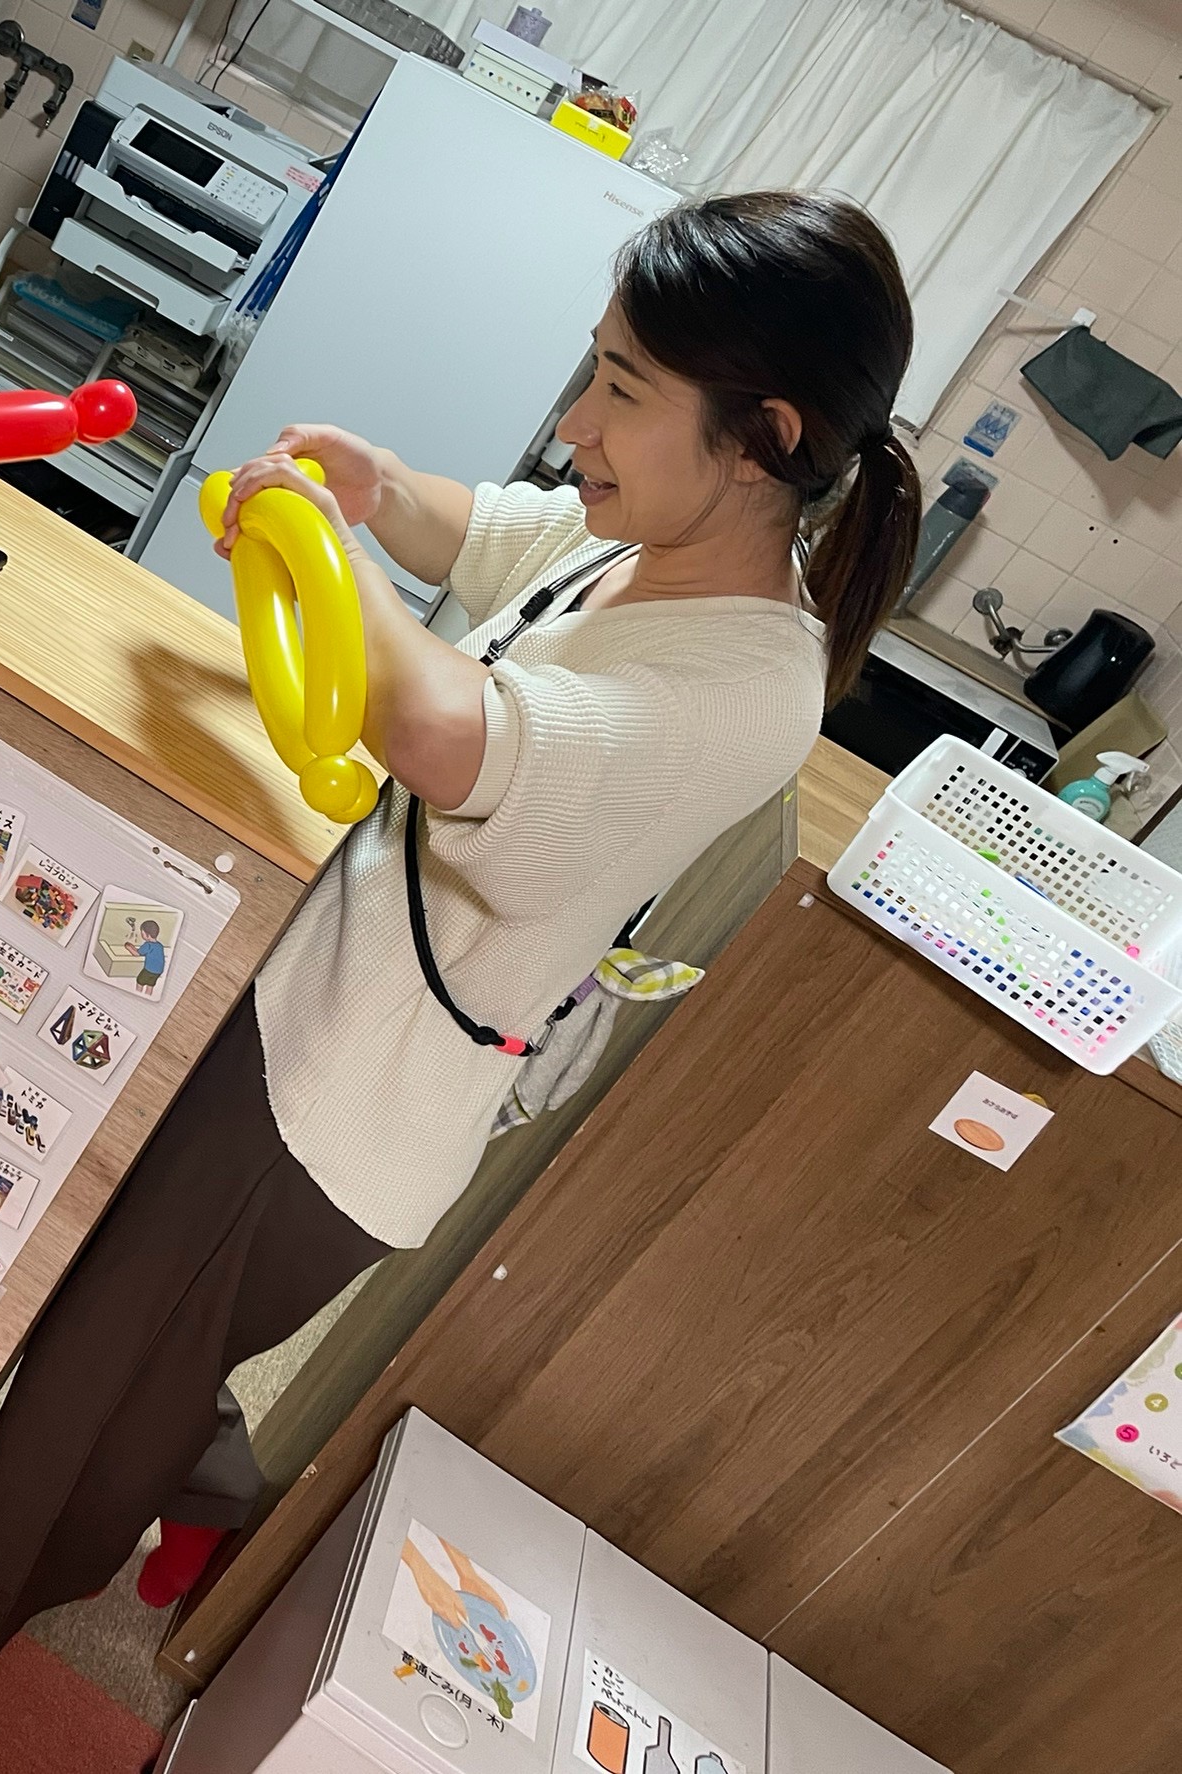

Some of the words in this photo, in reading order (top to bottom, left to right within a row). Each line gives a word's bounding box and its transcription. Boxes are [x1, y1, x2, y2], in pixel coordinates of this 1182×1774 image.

[207, 121, 233, 141] EPSON
[603, 190, 645, 218] Hisense
[39, 861, 78, 889] レゴブロック
[76, 1002, 121, 1037] マグビルト
[21, 1091, 44, 1108] トミカ
[603, 1666, 625, 1683] カン
[601, 1676, 625, 1695] ビン
